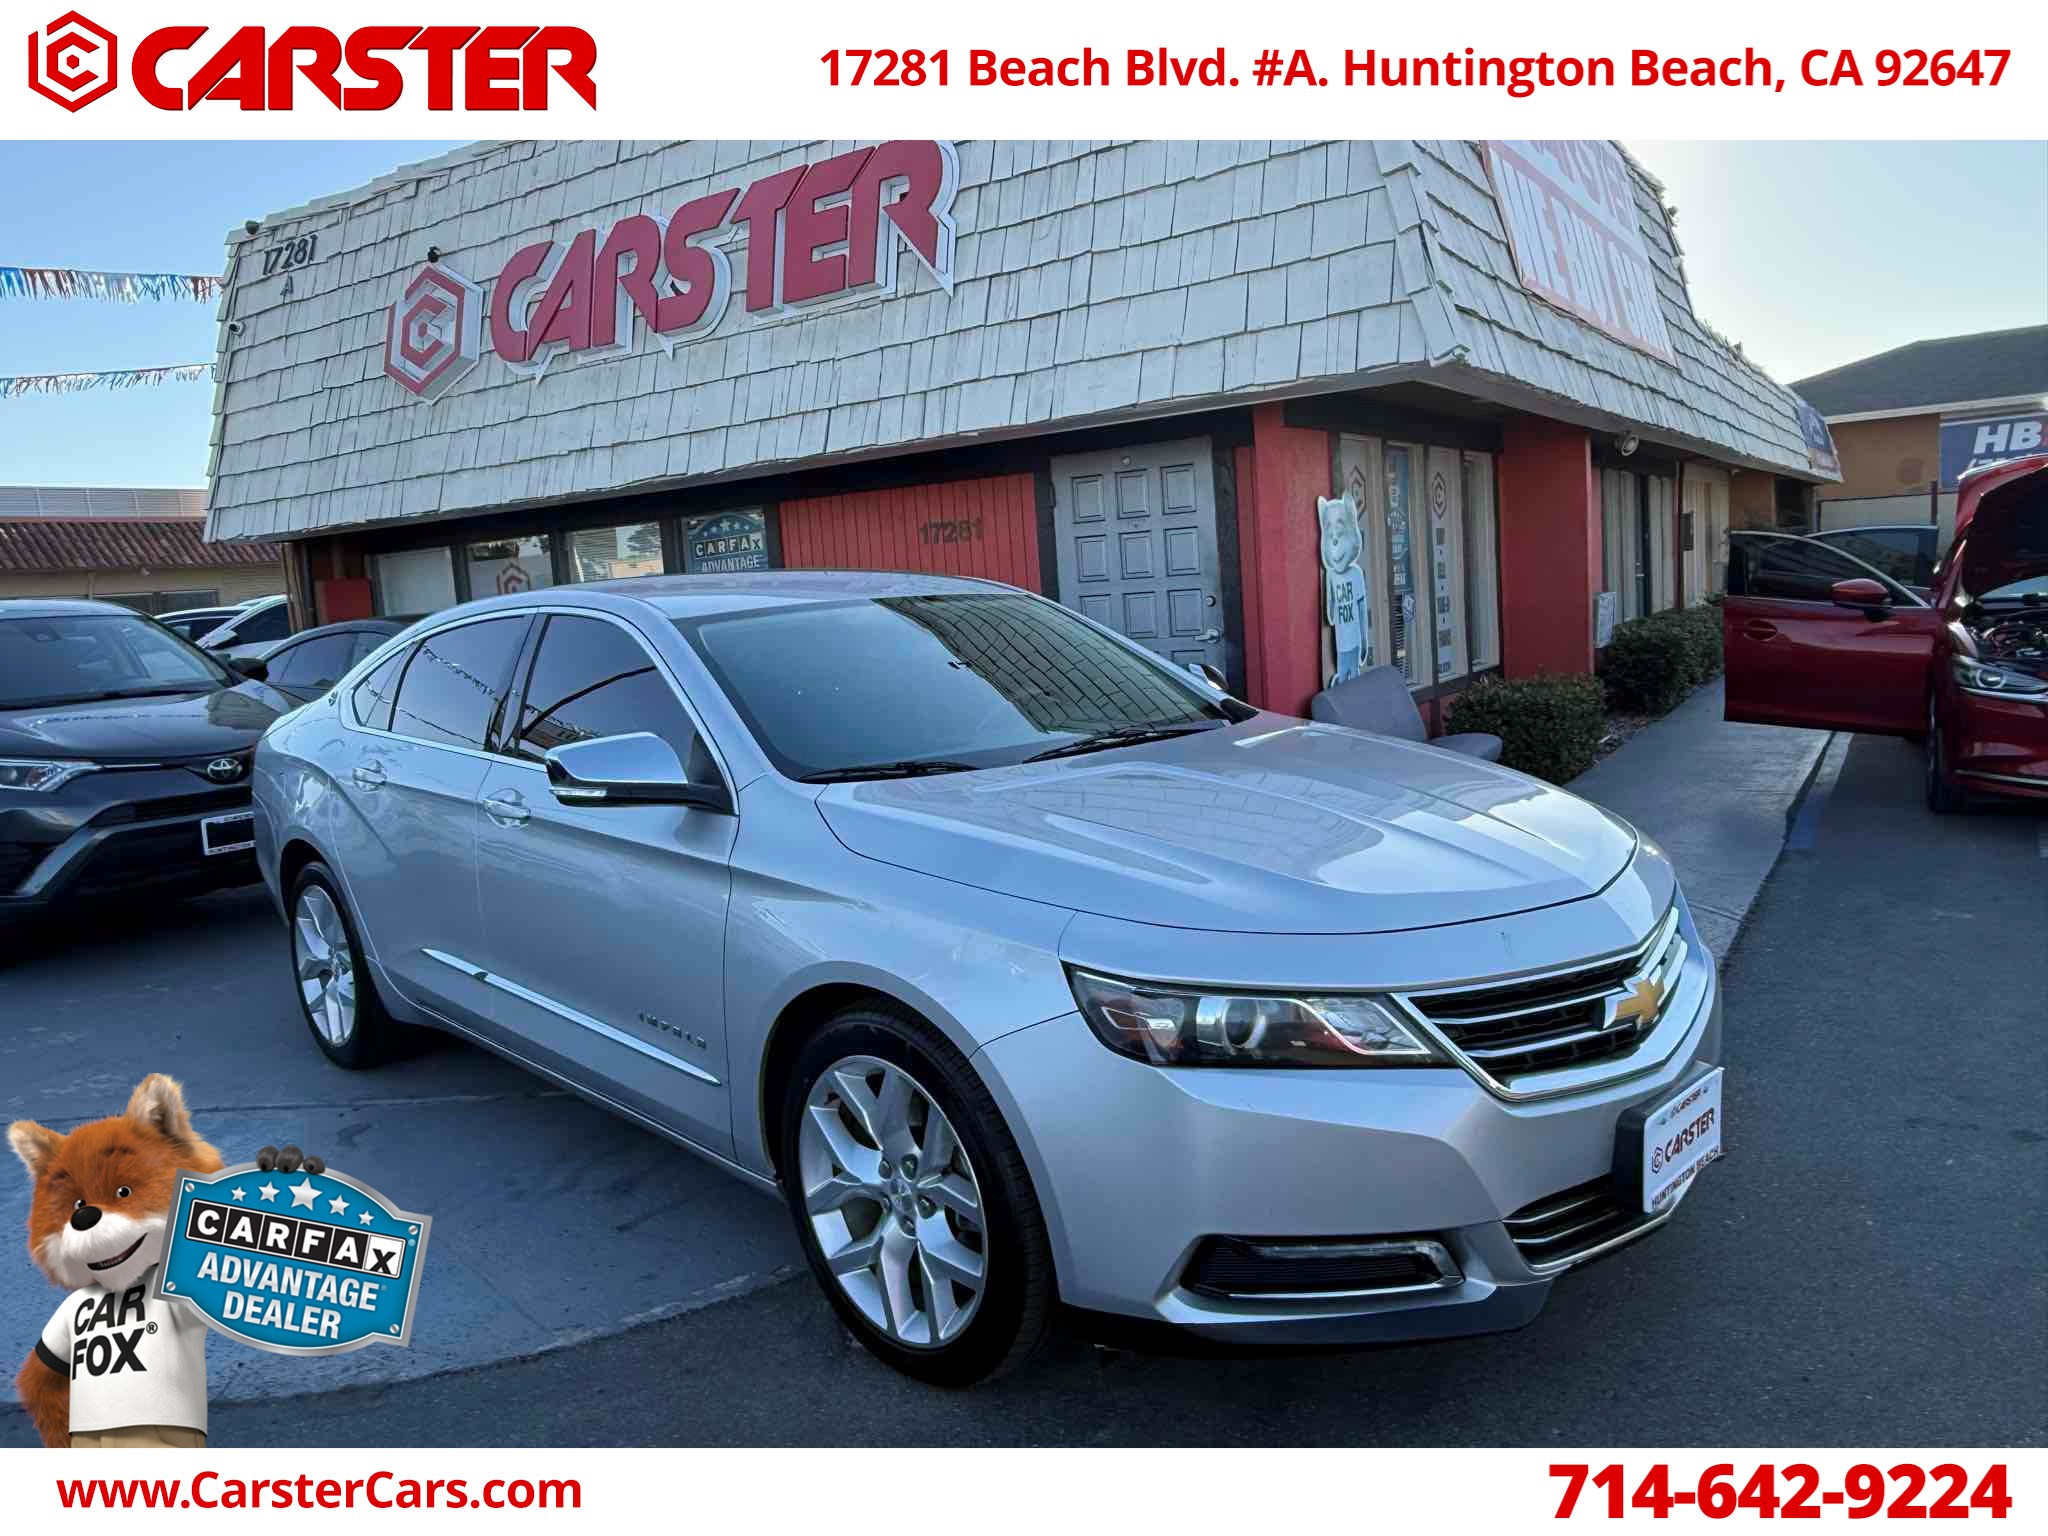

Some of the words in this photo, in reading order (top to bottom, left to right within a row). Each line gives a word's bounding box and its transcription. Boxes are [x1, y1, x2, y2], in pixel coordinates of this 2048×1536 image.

[262, 234, 319, 275] 17281
[490, 140, 947, 366] CARSTER
[1974, 421, 2042, 454] HB
[695, 534, 763, 558] CARFAX
[702, 555, 761, 573] ADVANTAGE
[1335, 581, 1353, 601] CAR
[1338, 602, 1354, 625] FOX
[1664, 1106, 1715, 1163] CARSTER
